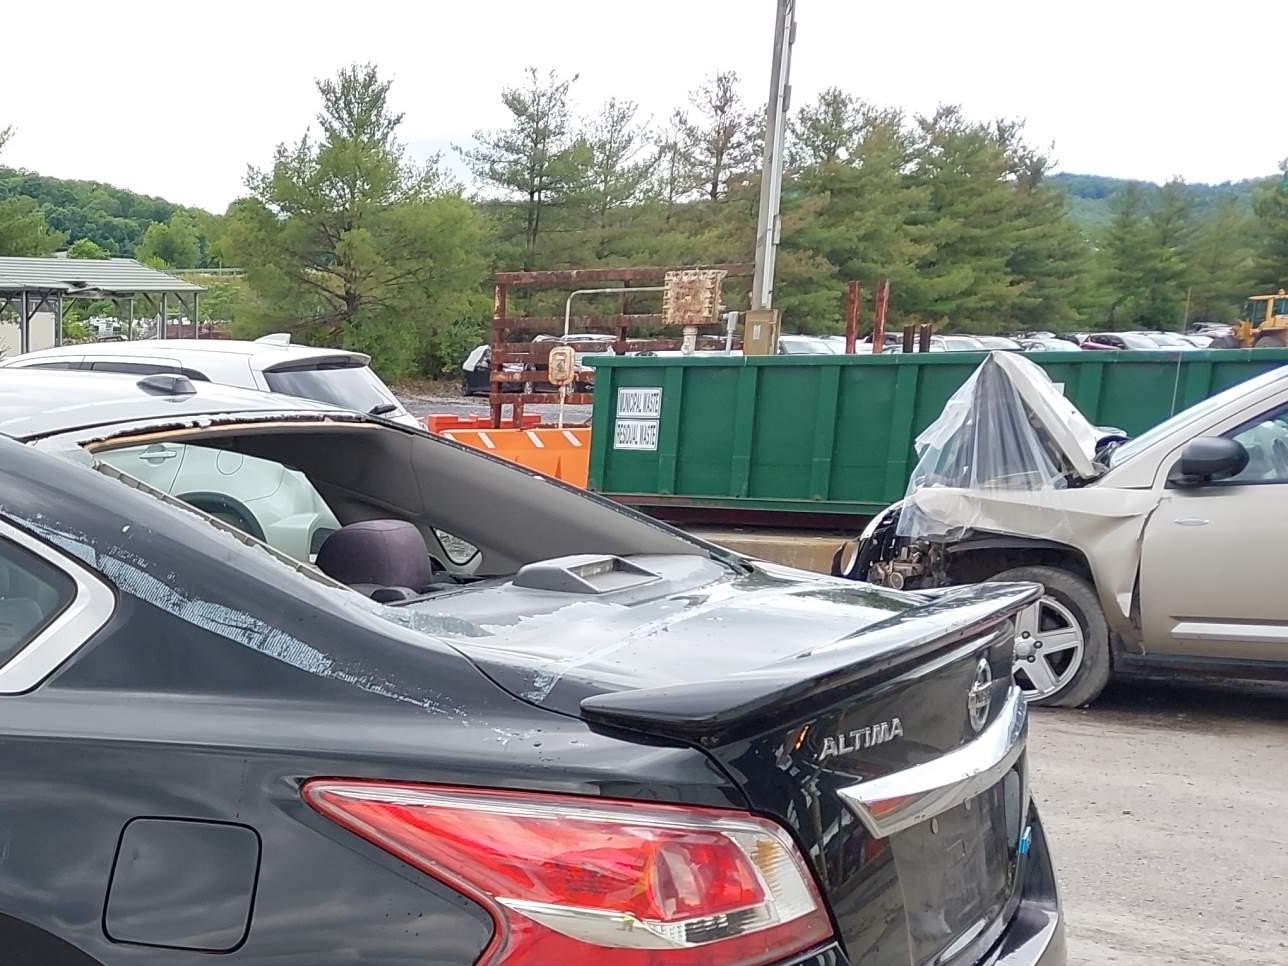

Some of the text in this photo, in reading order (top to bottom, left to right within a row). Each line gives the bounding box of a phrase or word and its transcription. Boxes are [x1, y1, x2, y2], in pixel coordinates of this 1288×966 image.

[643, 392, 659, 413] WASTE
[617, 423, 656, 445] RESIDUAL WASTE
[818, 717, 904, 761] ALTIMA
